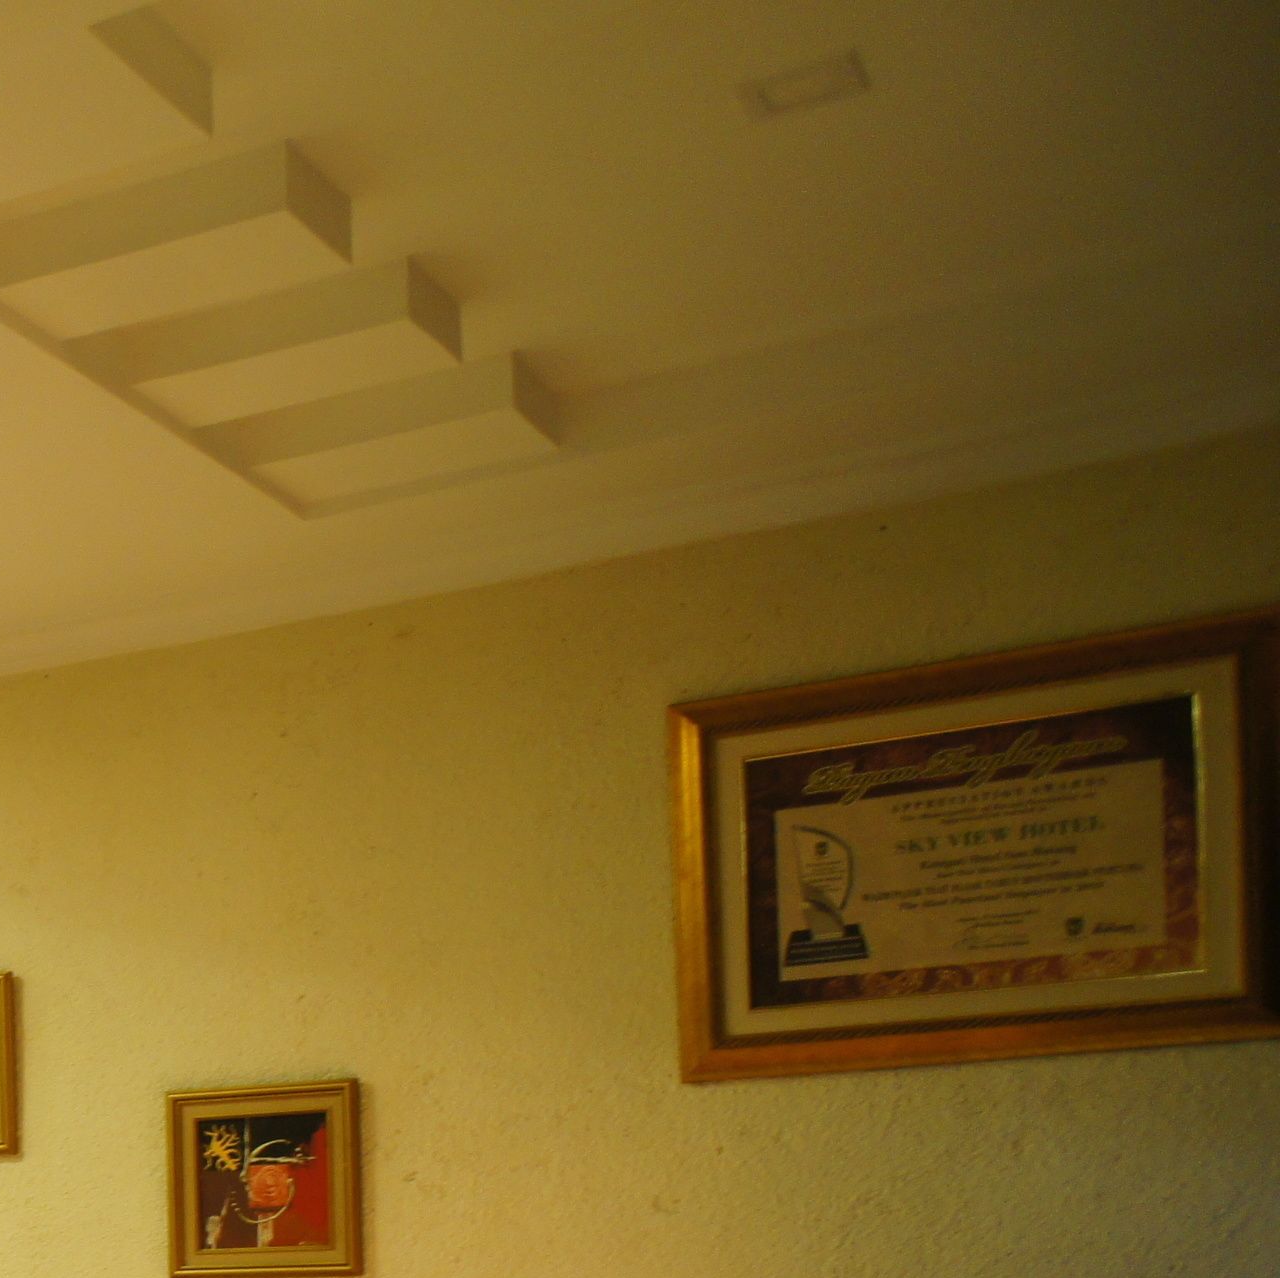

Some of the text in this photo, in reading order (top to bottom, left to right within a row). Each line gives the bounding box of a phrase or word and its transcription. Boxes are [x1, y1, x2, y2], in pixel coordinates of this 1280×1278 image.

[894, 834, 939, 854] SKY
[947, 826, 1008, 850] VIEW
[1017, 815, 1105, 841] HOTEL
